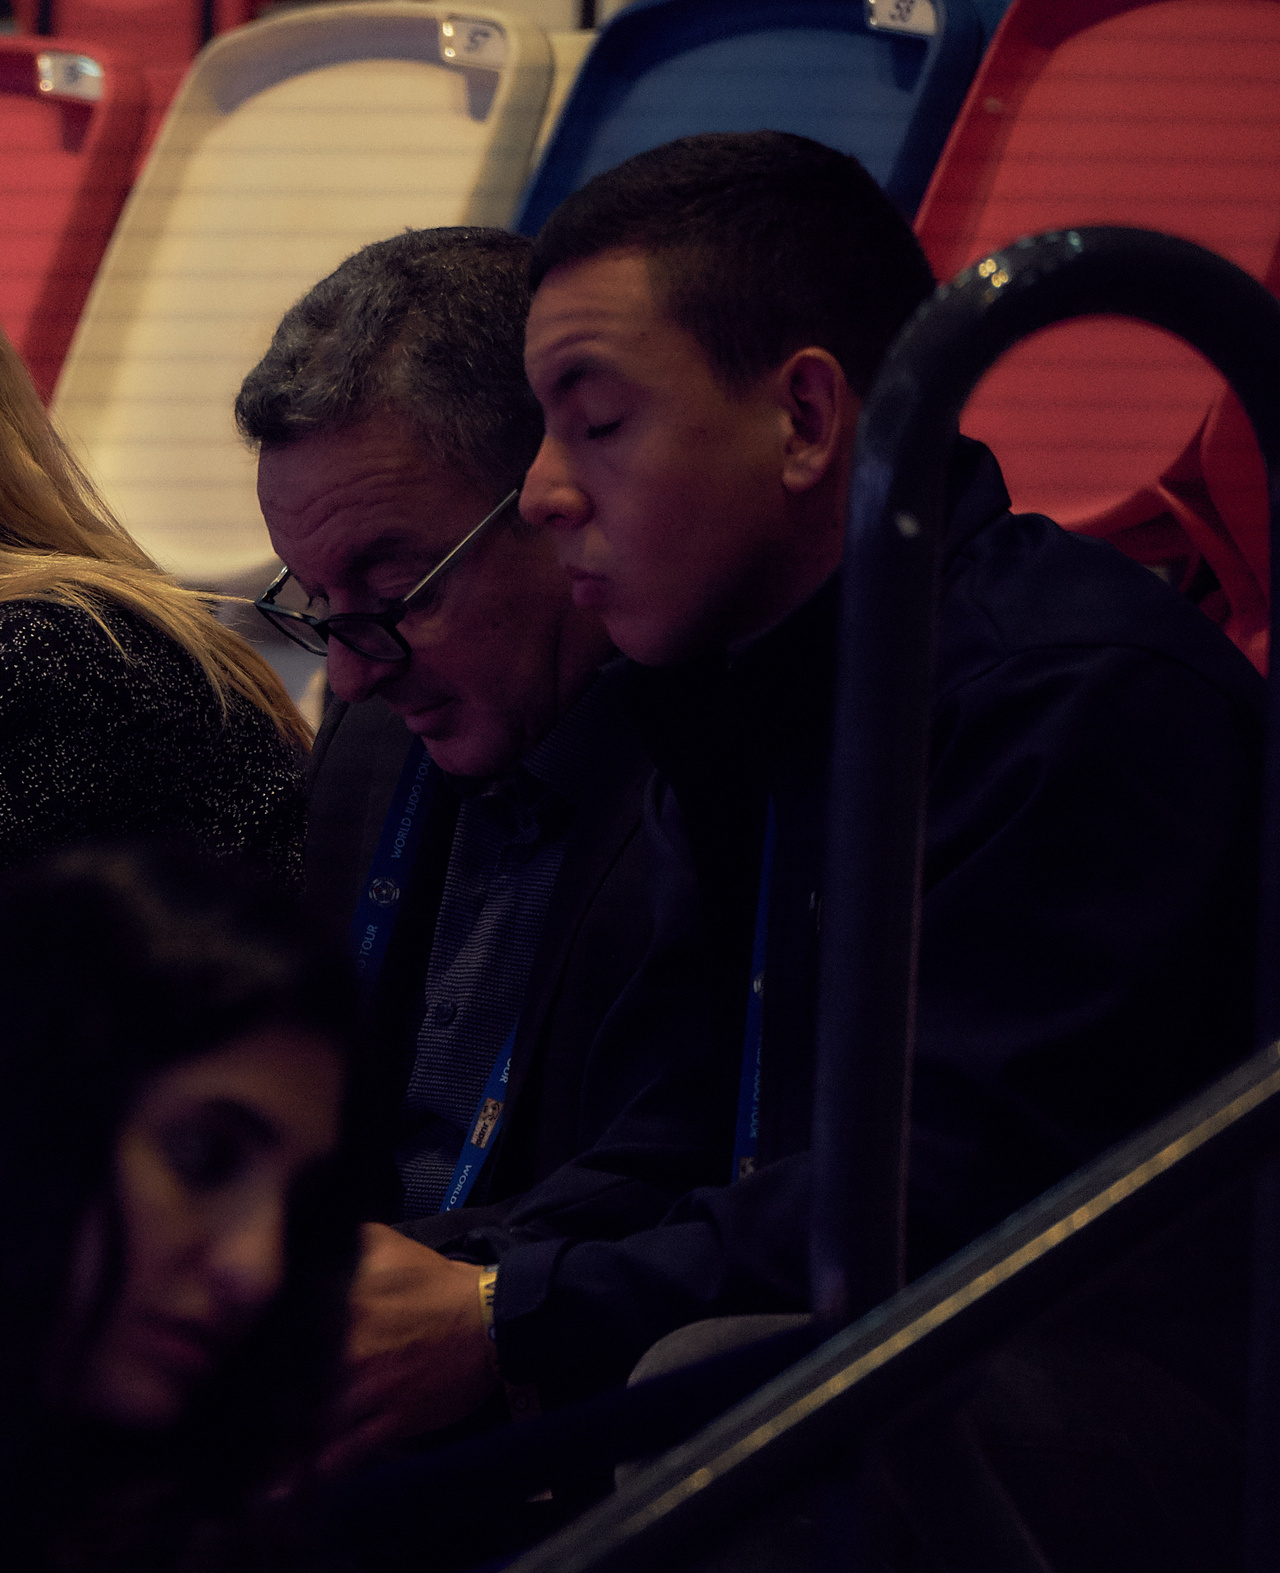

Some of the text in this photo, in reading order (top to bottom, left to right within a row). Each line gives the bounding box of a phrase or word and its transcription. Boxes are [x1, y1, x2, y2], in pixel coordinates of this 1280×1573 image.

[391, 817, 412, 859] WORLD
[405, 784, 422, 816] JUDO
[360, 924, 379, 956] TOUR
[450, 1164, 472, 1205] WORLD
